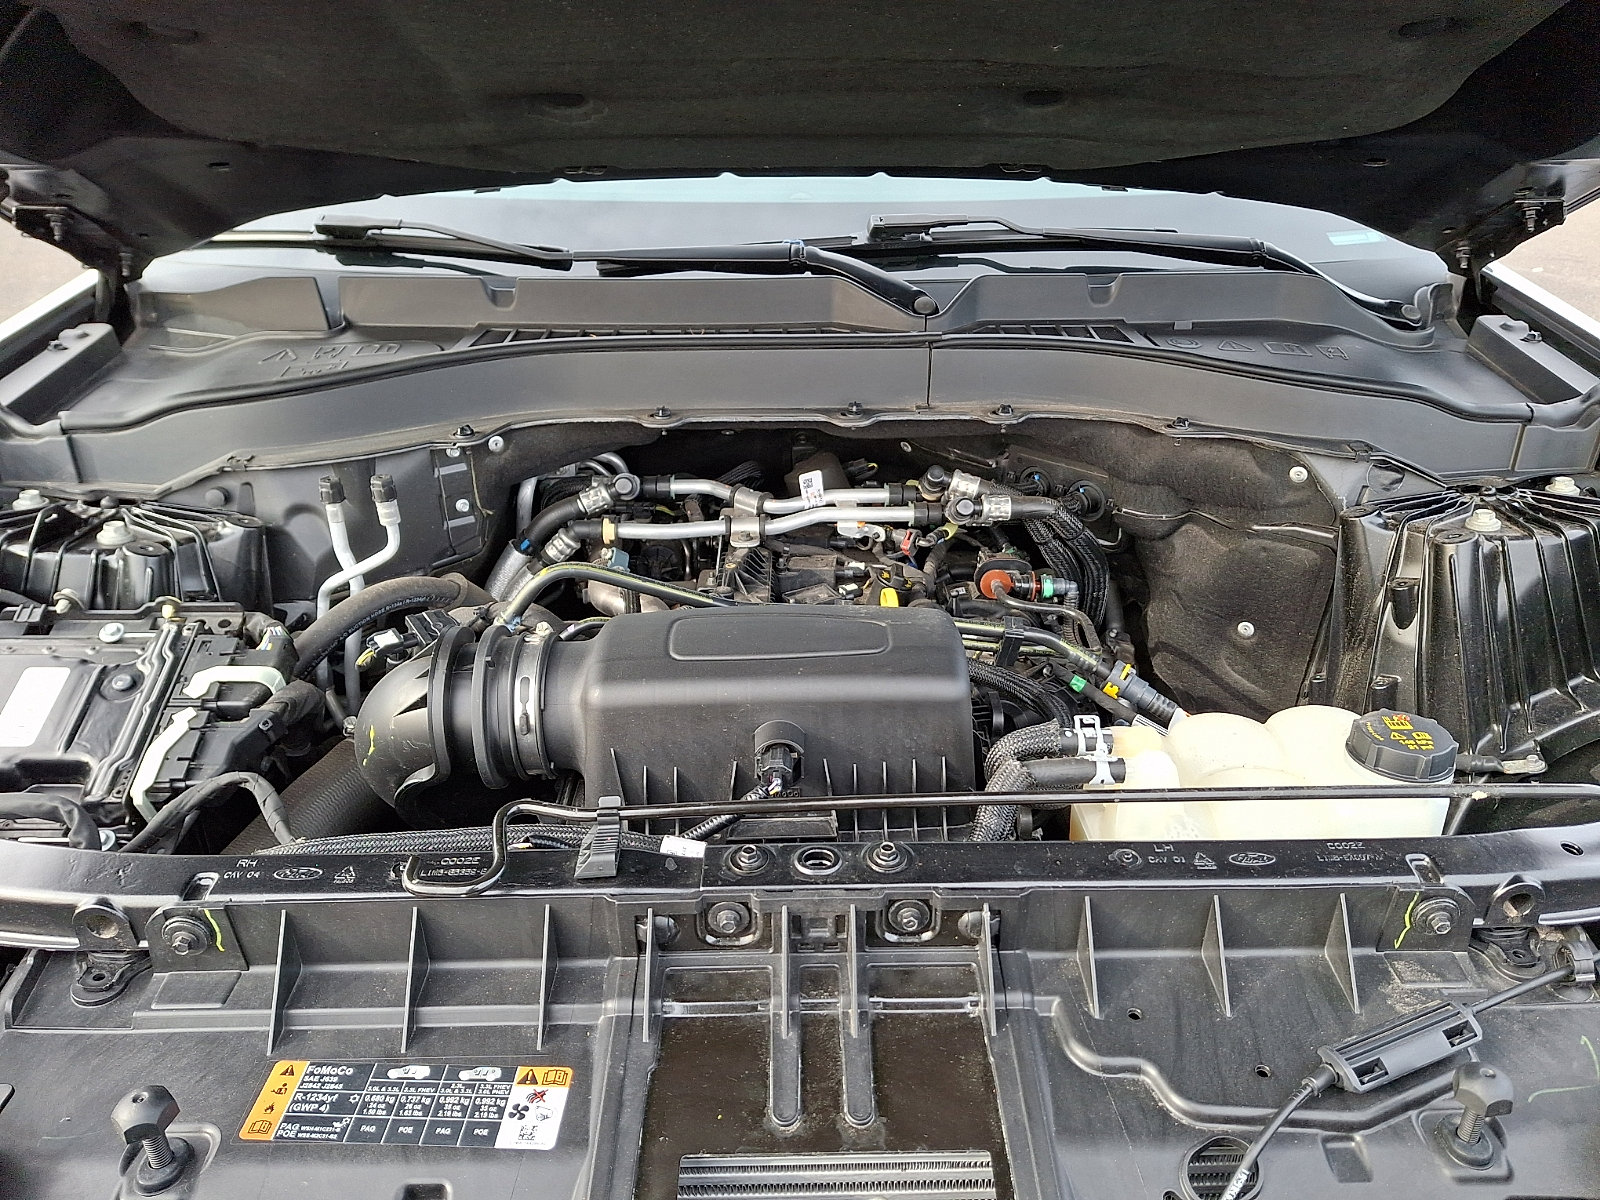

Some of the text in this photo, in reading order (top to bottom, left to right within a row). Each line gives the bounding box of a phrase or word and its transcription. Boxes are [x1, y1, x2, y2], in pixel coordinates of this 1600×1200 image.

[1153, 844, 1174, 852] LH
[236, 859, 258, 868] RH
[306, 1065, 354, 1075] FoMoCo
[294, 1093, 338, 1103] R-1234yf
[385, 1095, 395, 1104] kg
[421, 1096, 431, 1105] kg
[460, 1097, 470, 1105] kg
[496, 1098, 506, 1107] kg
[288, 1103, 330, 1113] (GWP 4)
[280, 1123, 300, 1131] PAG
[276, 1130, 296, 1138] POE
